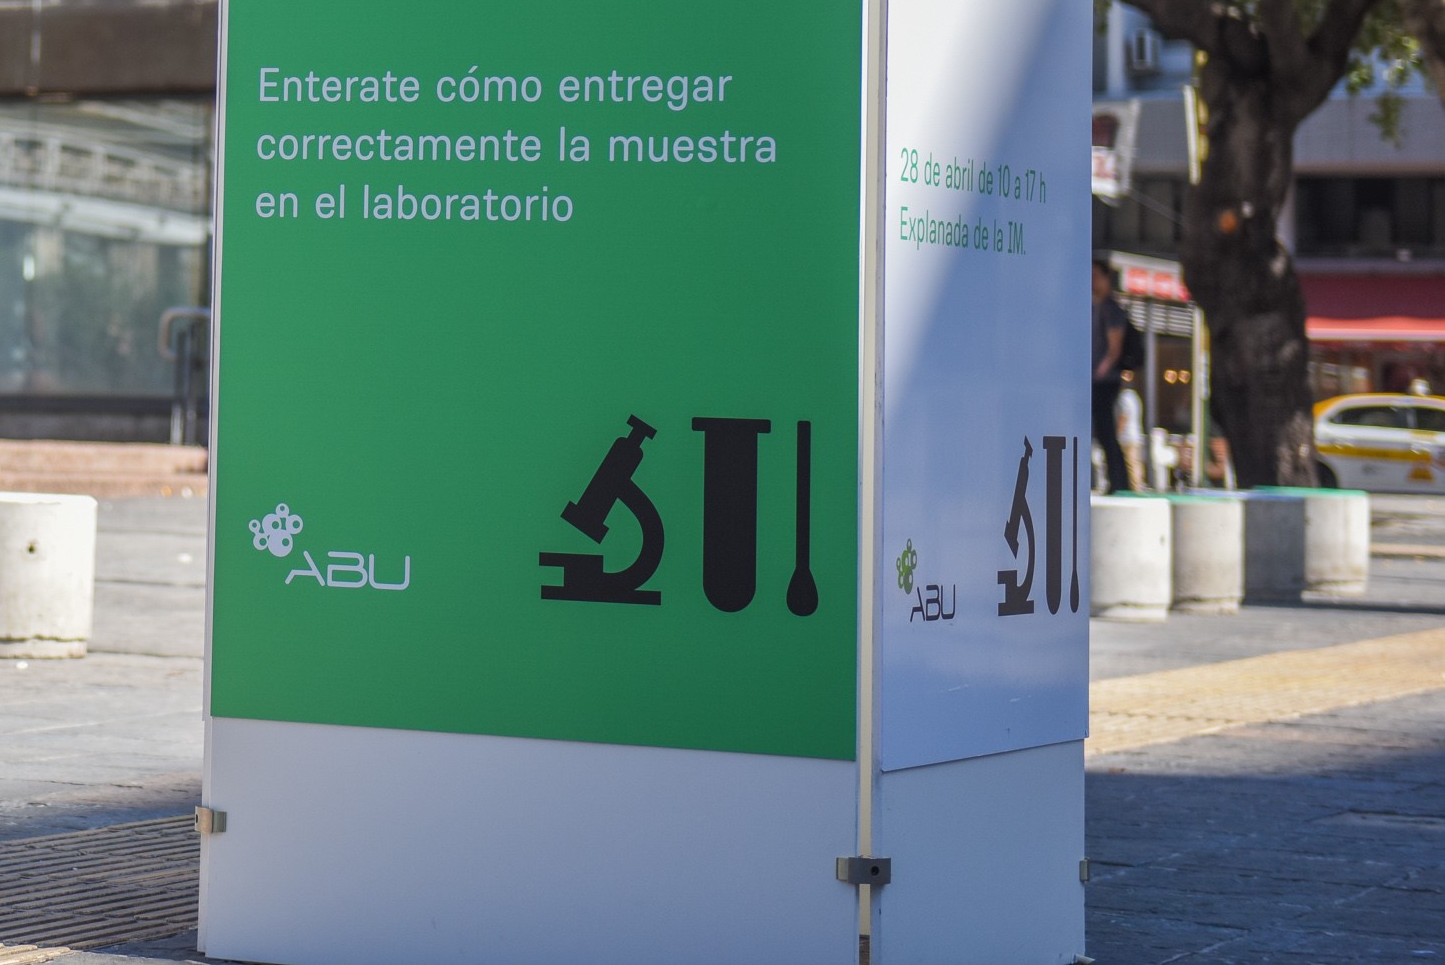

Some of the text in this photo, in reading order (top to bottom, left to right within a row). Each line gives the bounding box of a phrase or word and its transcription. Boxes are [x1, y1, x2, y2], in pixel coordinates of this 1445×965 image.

[260, 66, 732, 111] Enterate cómo entregar
[257, 127, 775, 162] correctamente la muestra
[900, 147, 1046, 204] 28 de abril de 10 a 17 h
[256, 185, 573, 221] en el laboratorio
[900, 206, 1026, 255] Explanada de la IM.
[284, 550, 411, 591] ABU
[909, 583, 956, 623] ABU
